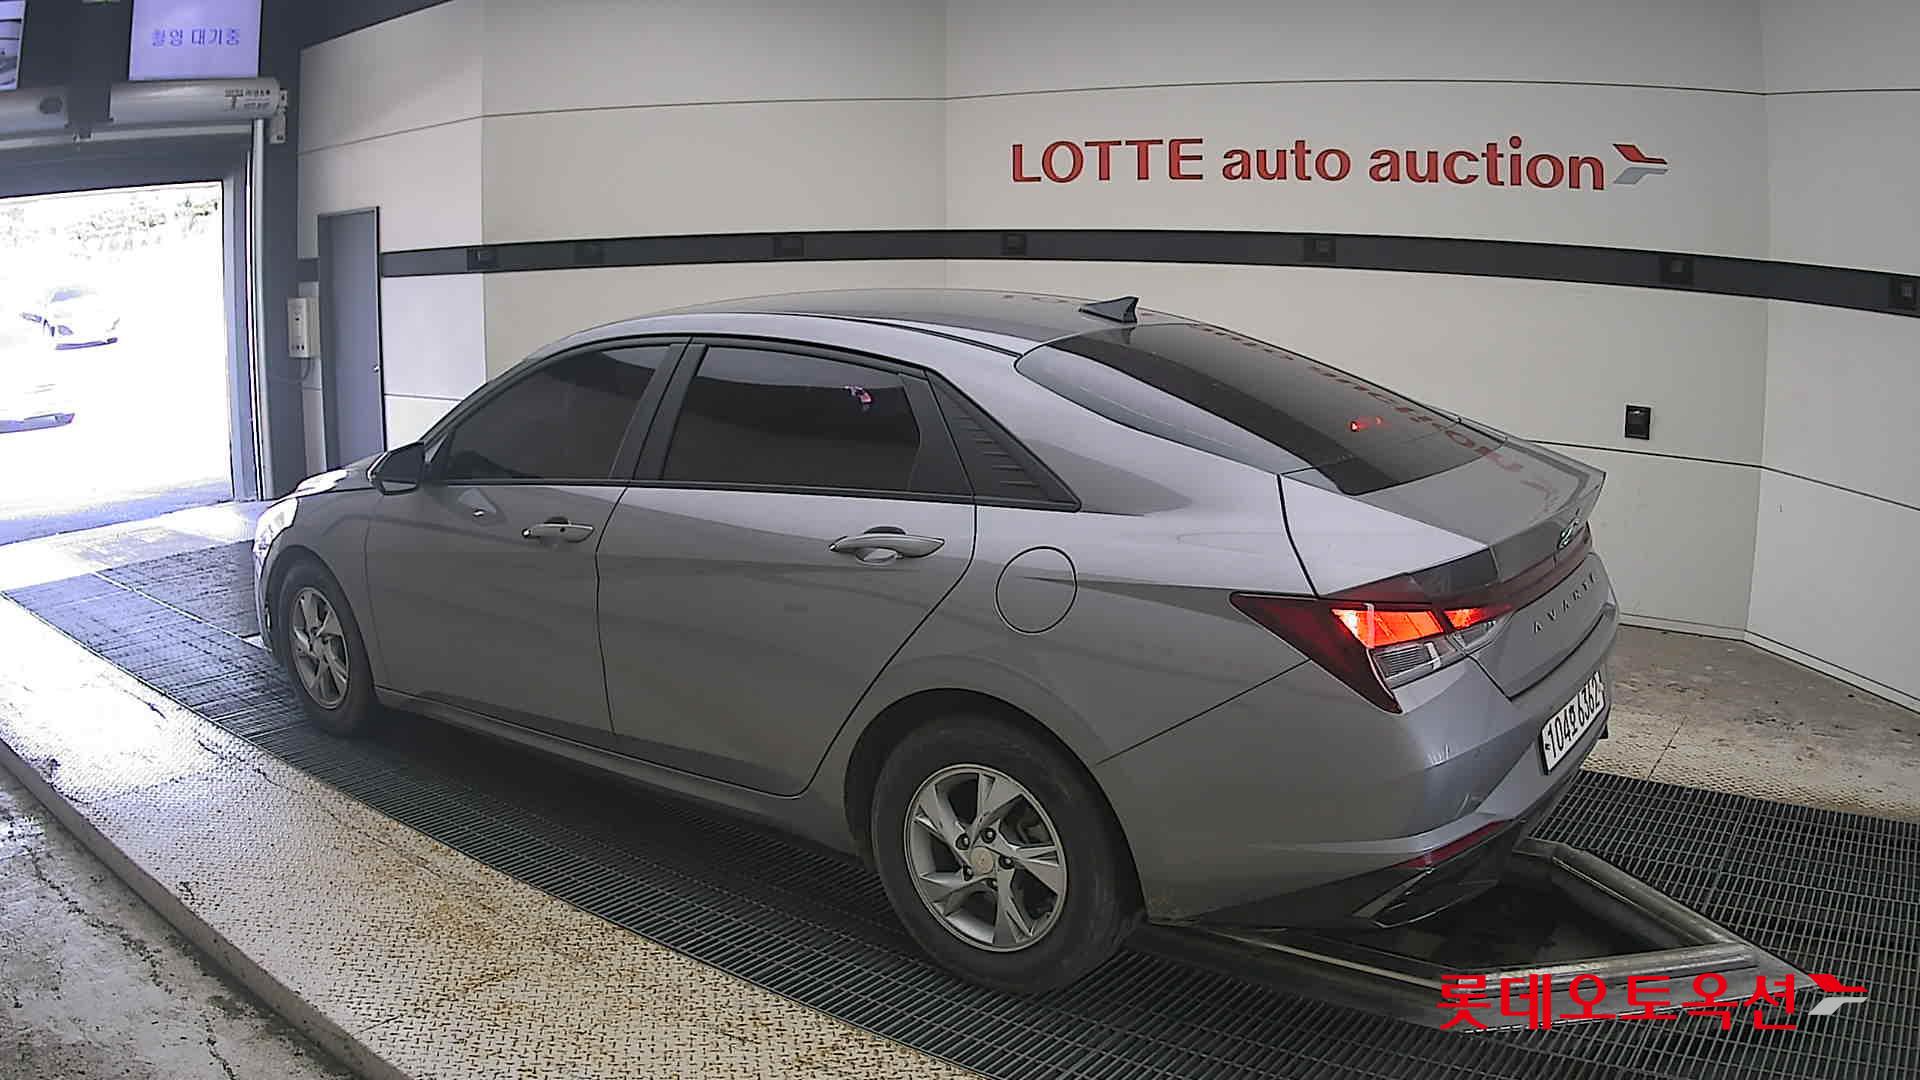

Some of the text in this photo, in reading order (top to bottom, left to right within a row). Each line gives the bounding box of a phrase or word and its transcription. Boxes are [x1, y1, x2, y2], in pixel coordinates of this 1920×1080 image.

[1011, 135, 1605, 192] LOTTE auto auction
